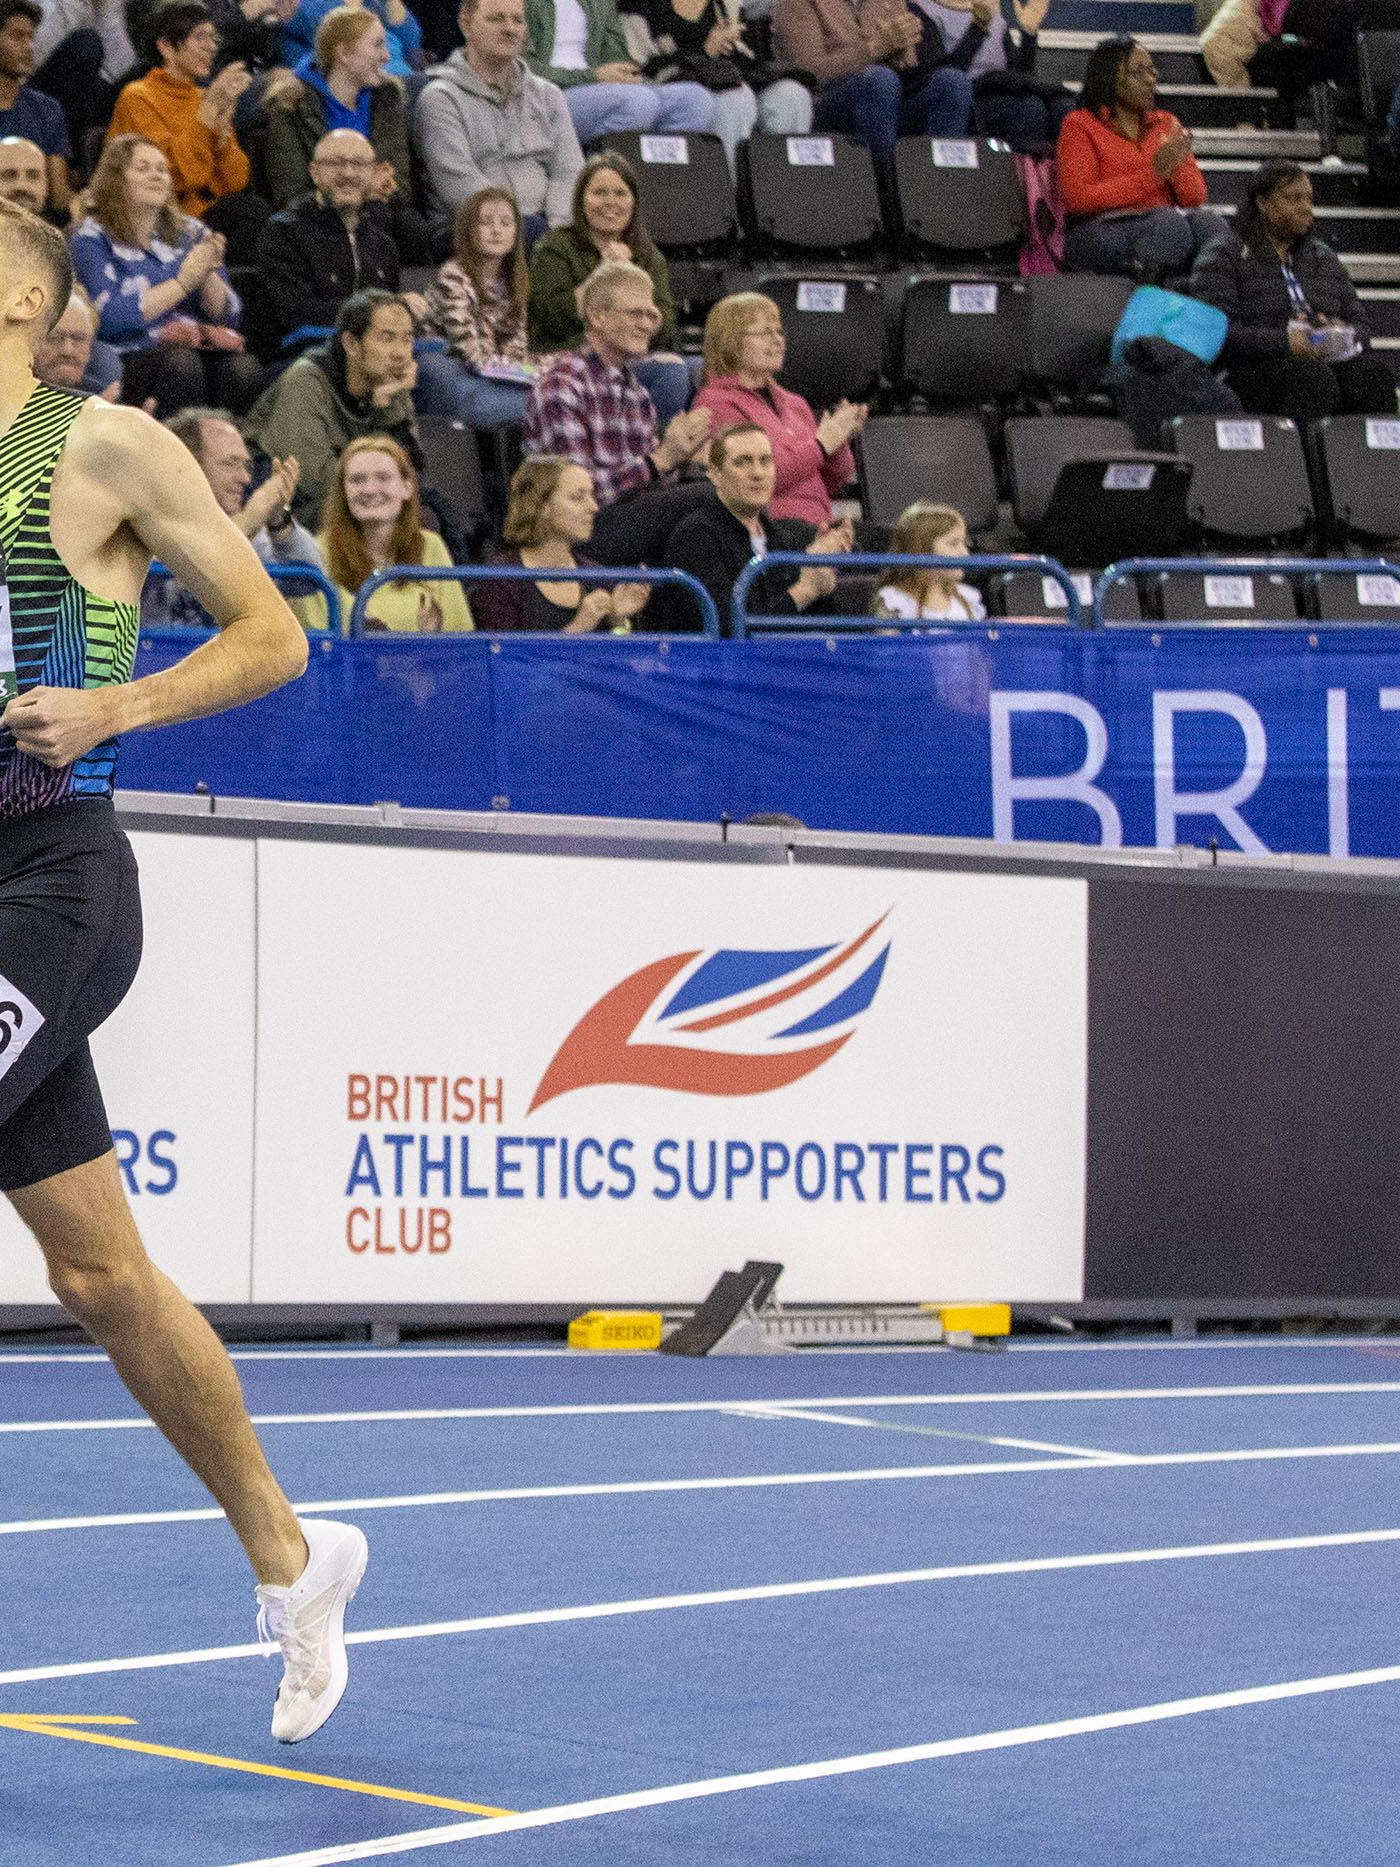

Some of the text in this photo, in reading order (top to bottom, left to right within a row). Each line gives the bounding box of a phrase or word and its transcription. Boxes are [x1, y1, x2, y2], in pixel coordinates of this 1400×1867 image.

[989, 687, 1400, 858] BRI
[346, 1073, 504, 1123] BRITISH
[345, 1134, 1007, 1204] ATHLETICS SUPPORTERS
[346, 1206, 453, 1255] CLUB
[602, 1325, 655, 1341] SEIKO
